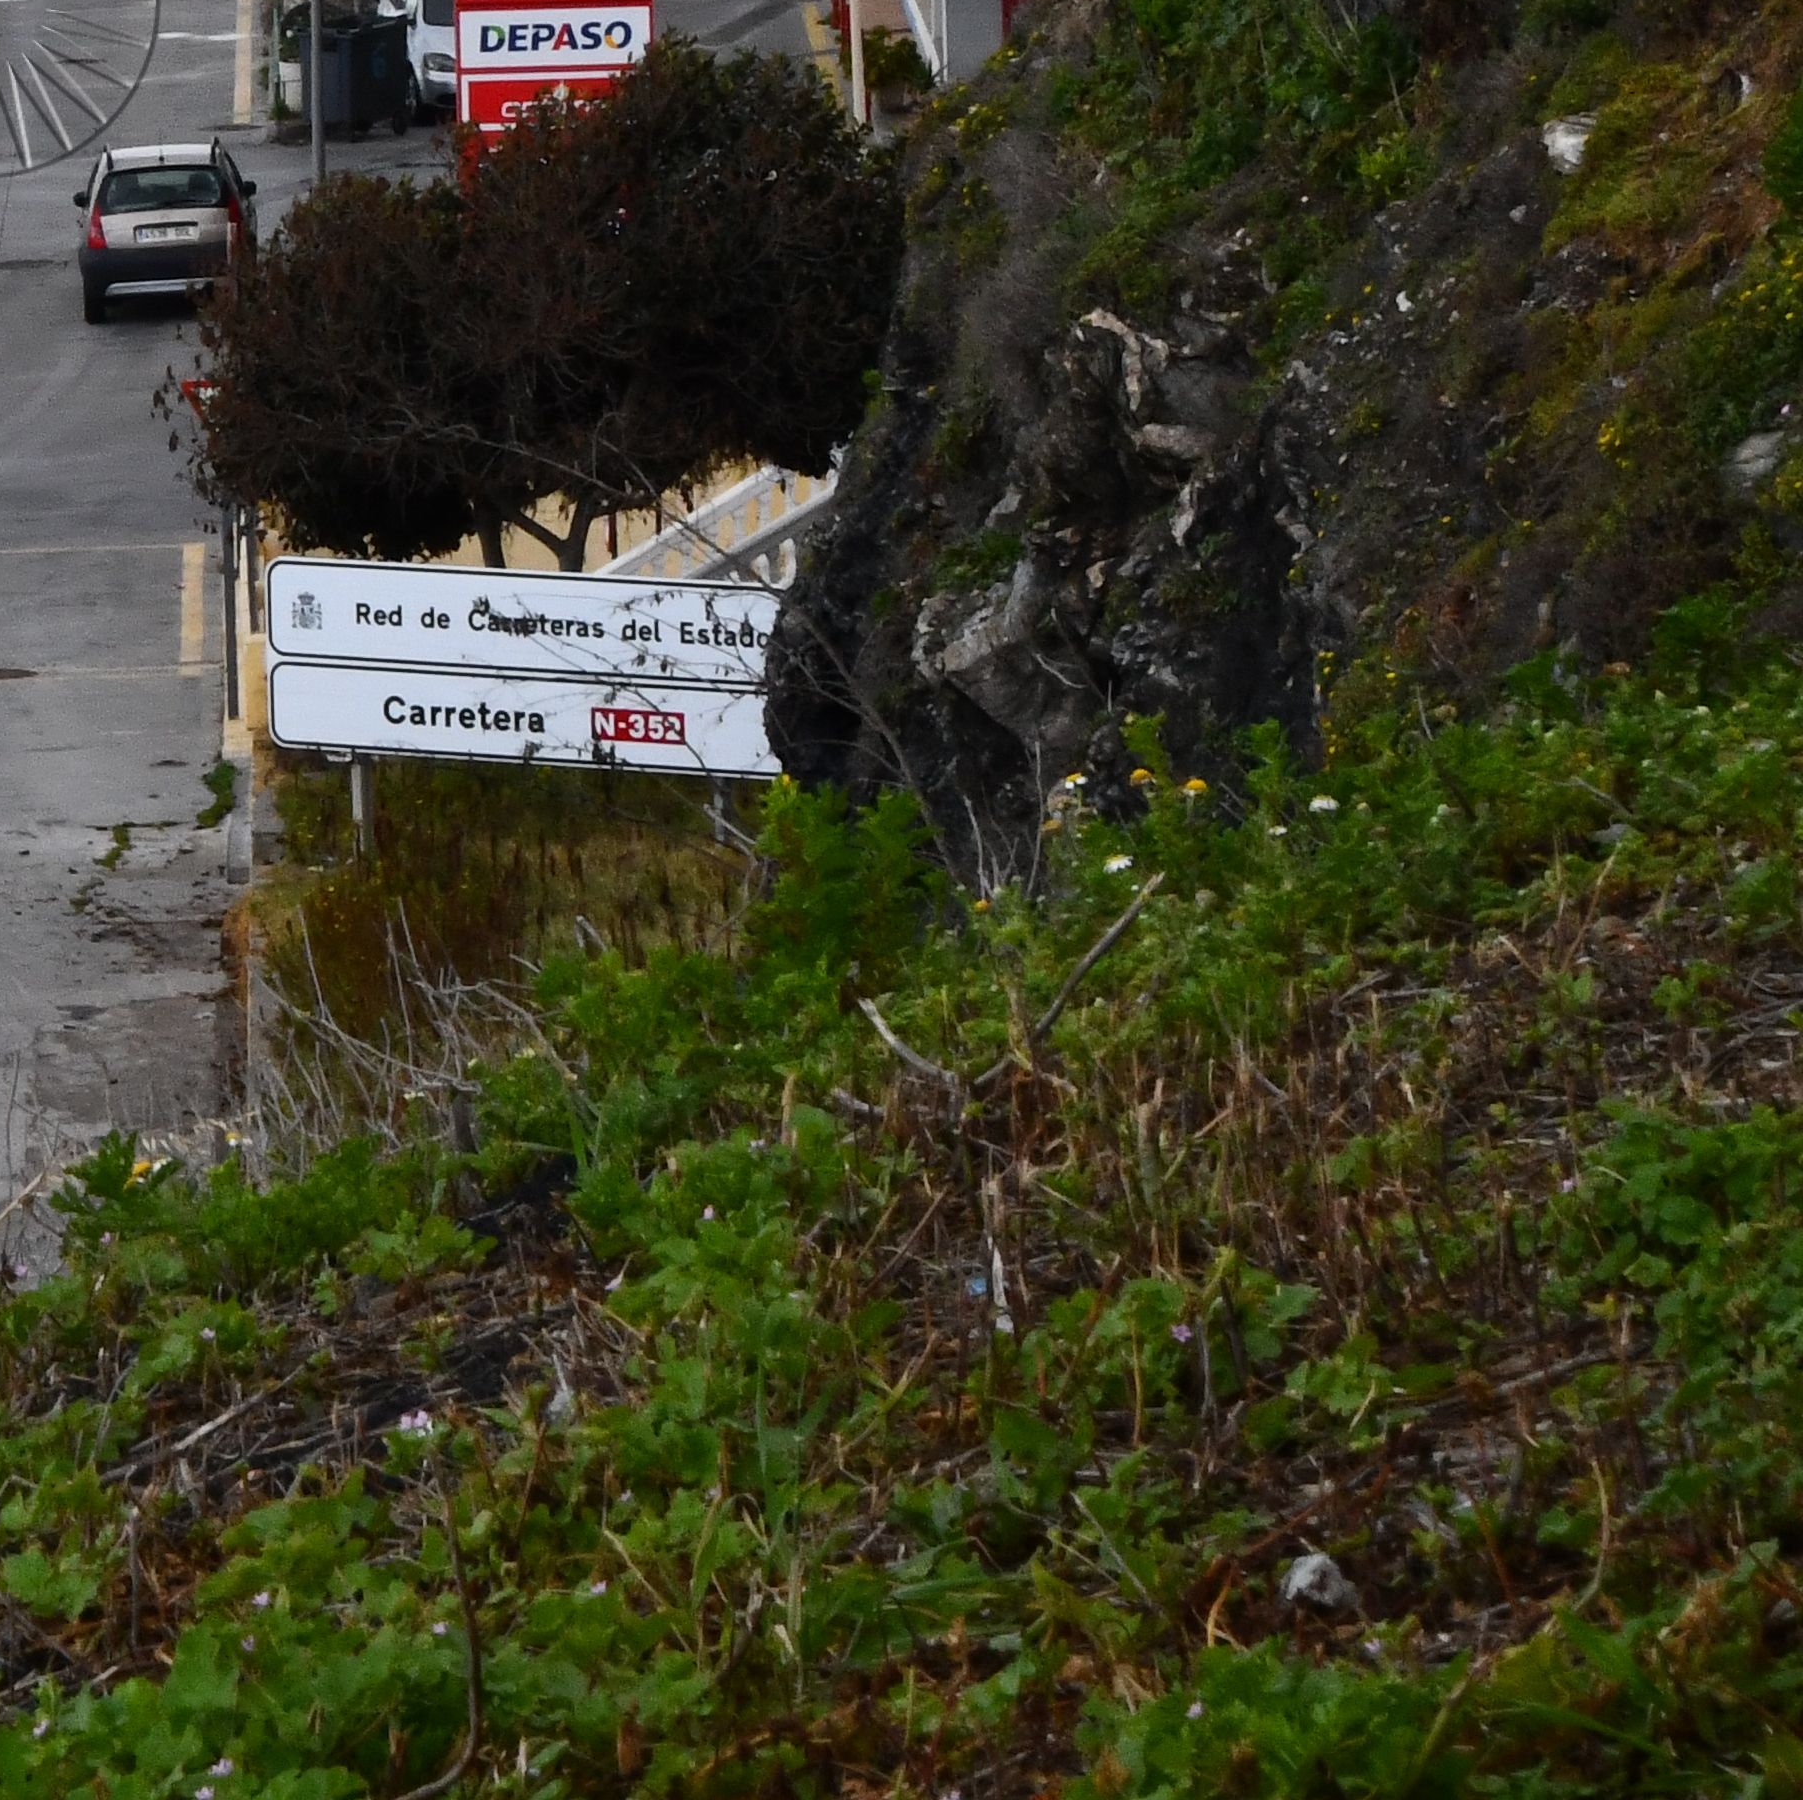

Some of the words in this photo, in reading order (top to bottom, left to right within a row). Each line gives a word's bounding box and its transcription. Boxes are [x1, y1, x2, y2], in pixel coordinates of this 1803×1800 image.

[479, 21, 633, 53] DEPASO
[355, 602, 403, 627] Red
[421, 606, 451, 630] de
[621, 619, 663, 643] del
[679, 620, 770, 649] Estado
[382, 694, 546, 734] Carretera
[593, 710, 682, 741] N-352
